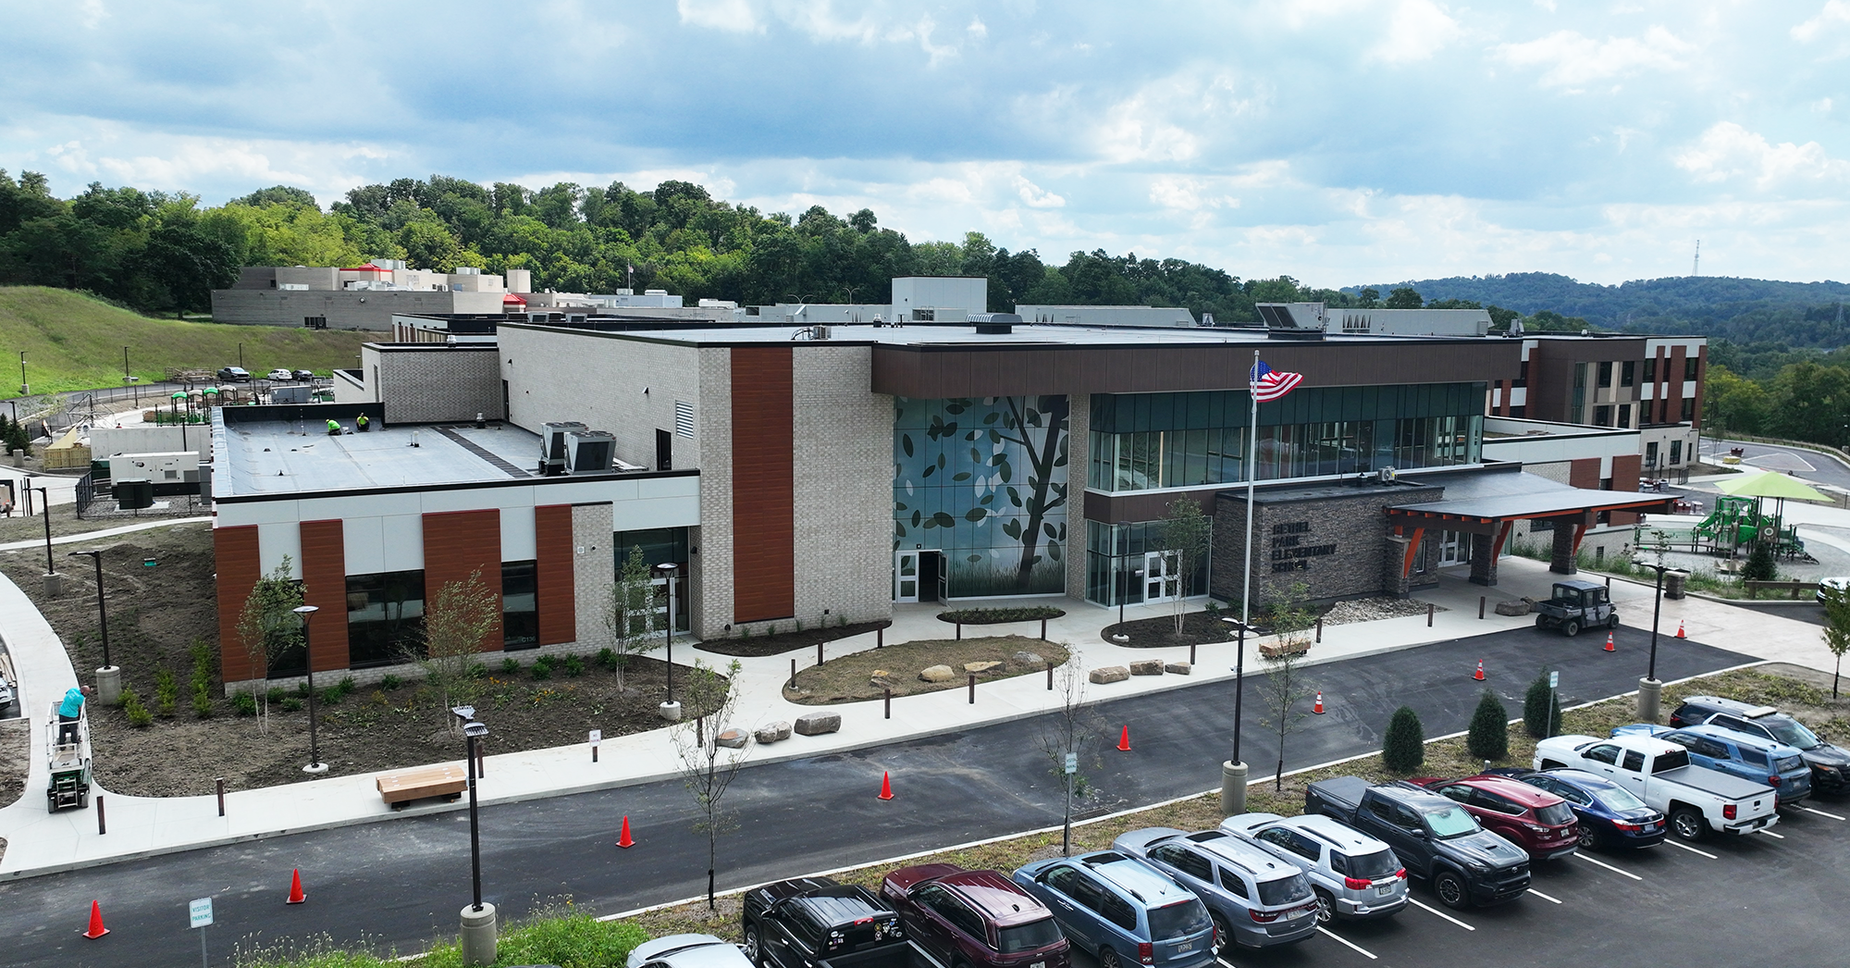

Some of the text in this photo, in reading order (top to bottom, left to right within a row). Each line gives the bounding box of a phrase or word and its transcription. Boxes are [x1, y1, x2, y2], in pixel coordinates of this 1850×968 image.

[1273, 522, 1311, 534] BETHEL
[1272, 535, 1300, 547] PARK
[1272, 544, 1337, 560] ELEMENTARY
[192, 913, 211, 921] PARKING
